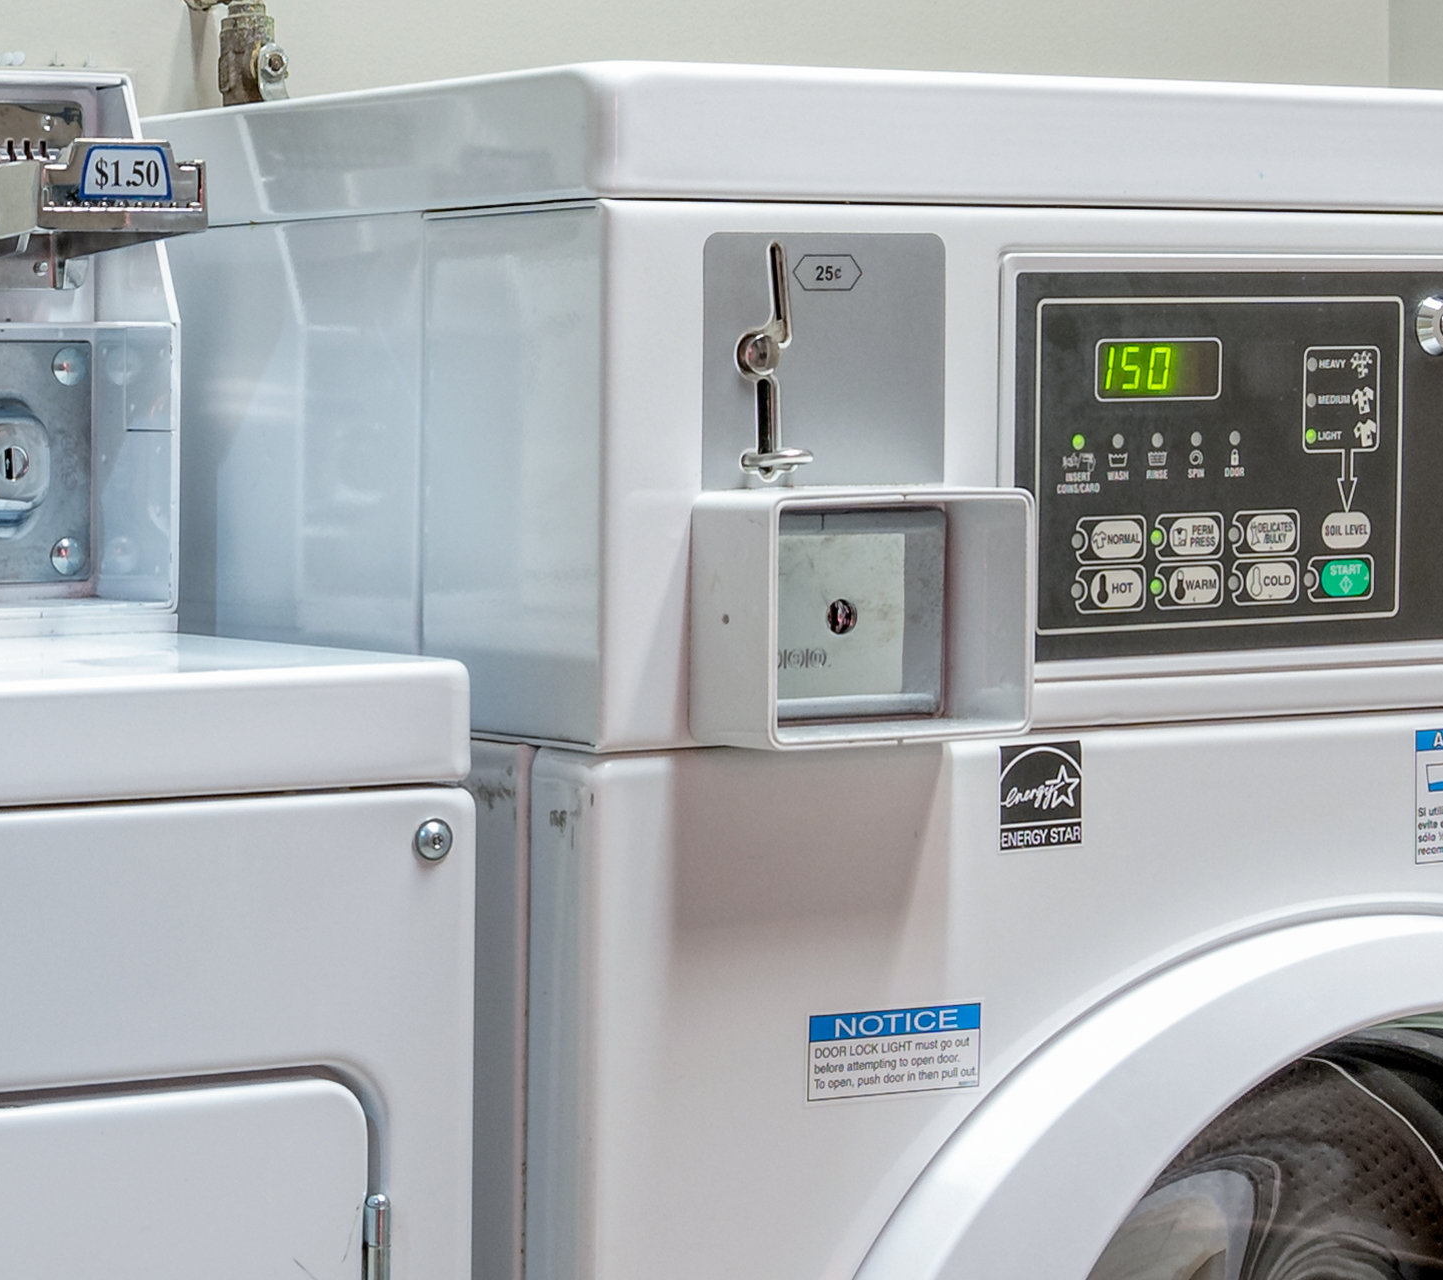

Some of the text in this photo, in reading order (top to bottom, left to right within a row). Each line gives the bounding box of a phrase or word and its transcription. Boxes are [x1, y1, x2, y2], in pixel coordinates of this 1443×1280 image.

[94, 158, 160, 190] $1.50
[1104, 346, 1171, 390] 150
[1319, 359, 1346, 369] HEAVY
[1318, 395, 1350, 405] MEDIUM
[1318, 431, 1342, 440] LIGHT
[1191, 525, 1214, 536] PERM
[1258, 522, 1293, 533] DELICATES
[1324, 524, 1368, 536] SOIL LEVEL
[1107, 533, 1140, 545] NORMAL
[1190, 536, 1216, 548] PRESS
[1330, 565, 1362, 576] START
[1186, 578, 1216, 590] WARM
[1263, 575, 1291, 586] COLD
[1112, 583, 1133, 593] HOT
[1005, 784, 1055, 809] energy
[1001, 827, 1081, 848] ENERGY STAR
[835, 1009, 958, 1038] NOTICE
[815, 1037, 969, 1059] DOOR LOCK LIGHT must go out
[814, 1053, 960, 1074] before attempting to open door.
[814, 1078, 825, 1089] To
[828, 1079, 854, 1090] open,
[857, 1074, 880, 1088] push
[884, 1073, 904, 1084] door
[907, 1072, 915, 1081] in
[918, 1070, 938, 1081] then
[941, 1068, 957, 1080] pull
